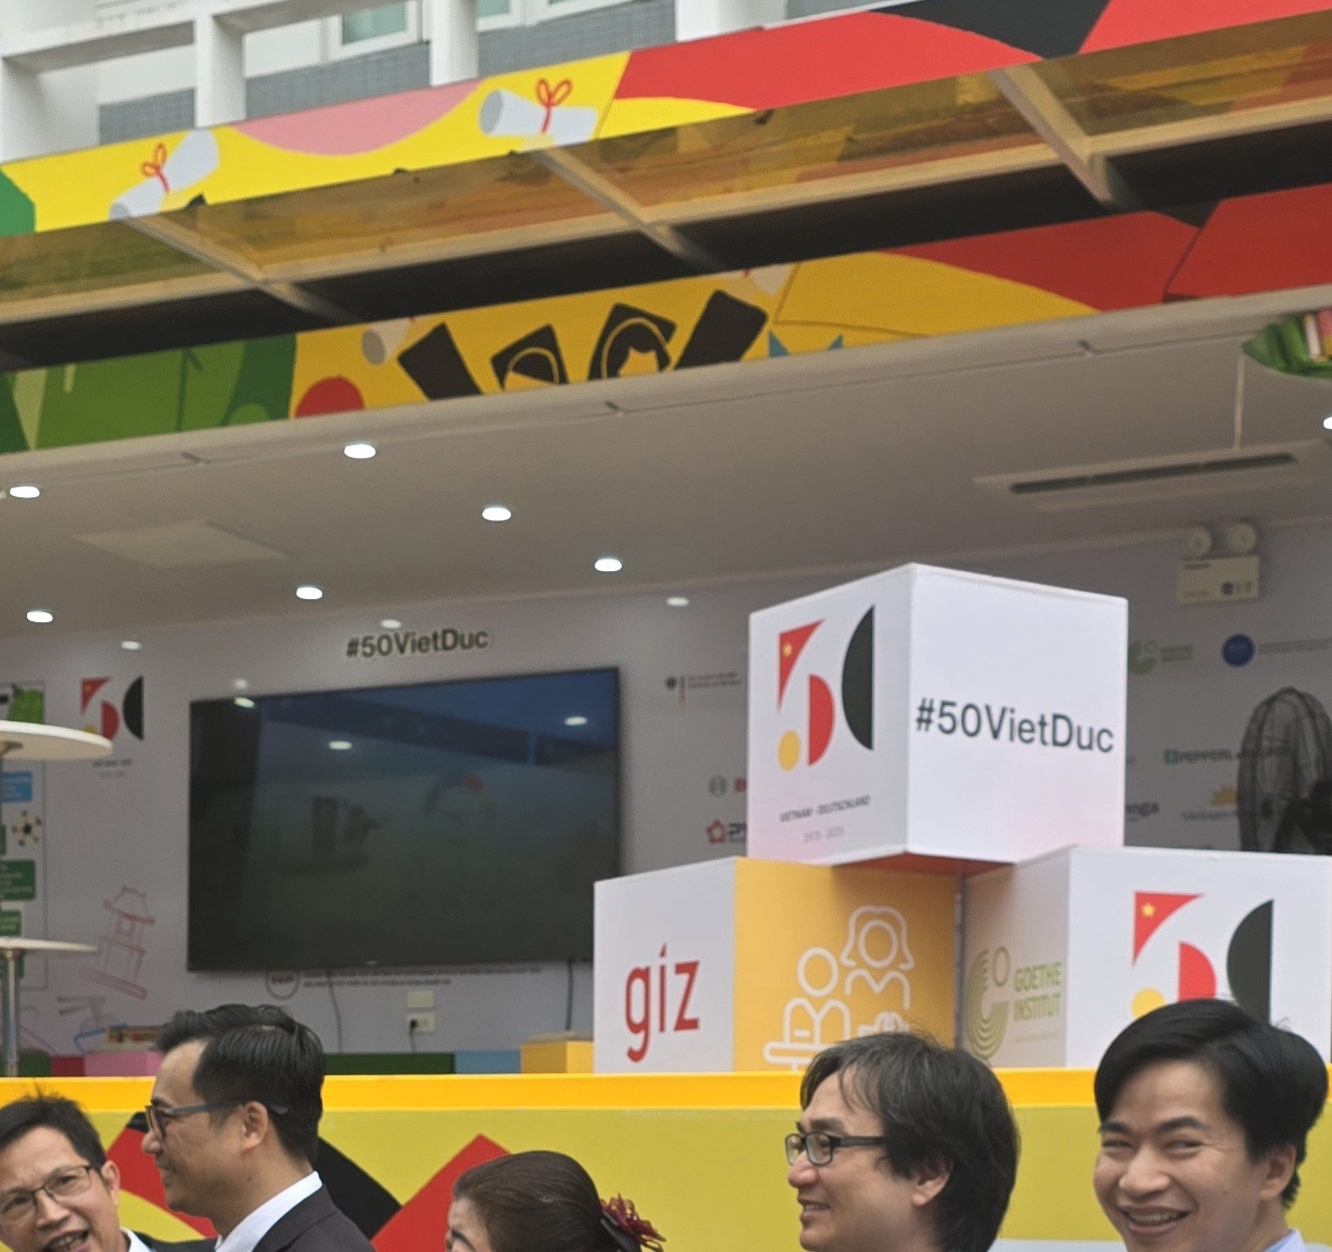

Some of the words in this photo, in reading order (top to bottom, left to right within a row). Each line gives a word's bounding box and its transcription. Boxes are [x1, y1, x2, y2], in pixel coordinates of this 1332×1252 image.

[346, 628, 489, 658] #50VietDuc
[915, 696, 1114, 753] #50VietDuc
[1014, 961, 1062, 993] GOETHE
[625, 942, 700, 1063] giz
[1014, 992, 1062, 1022] INSTITUT
